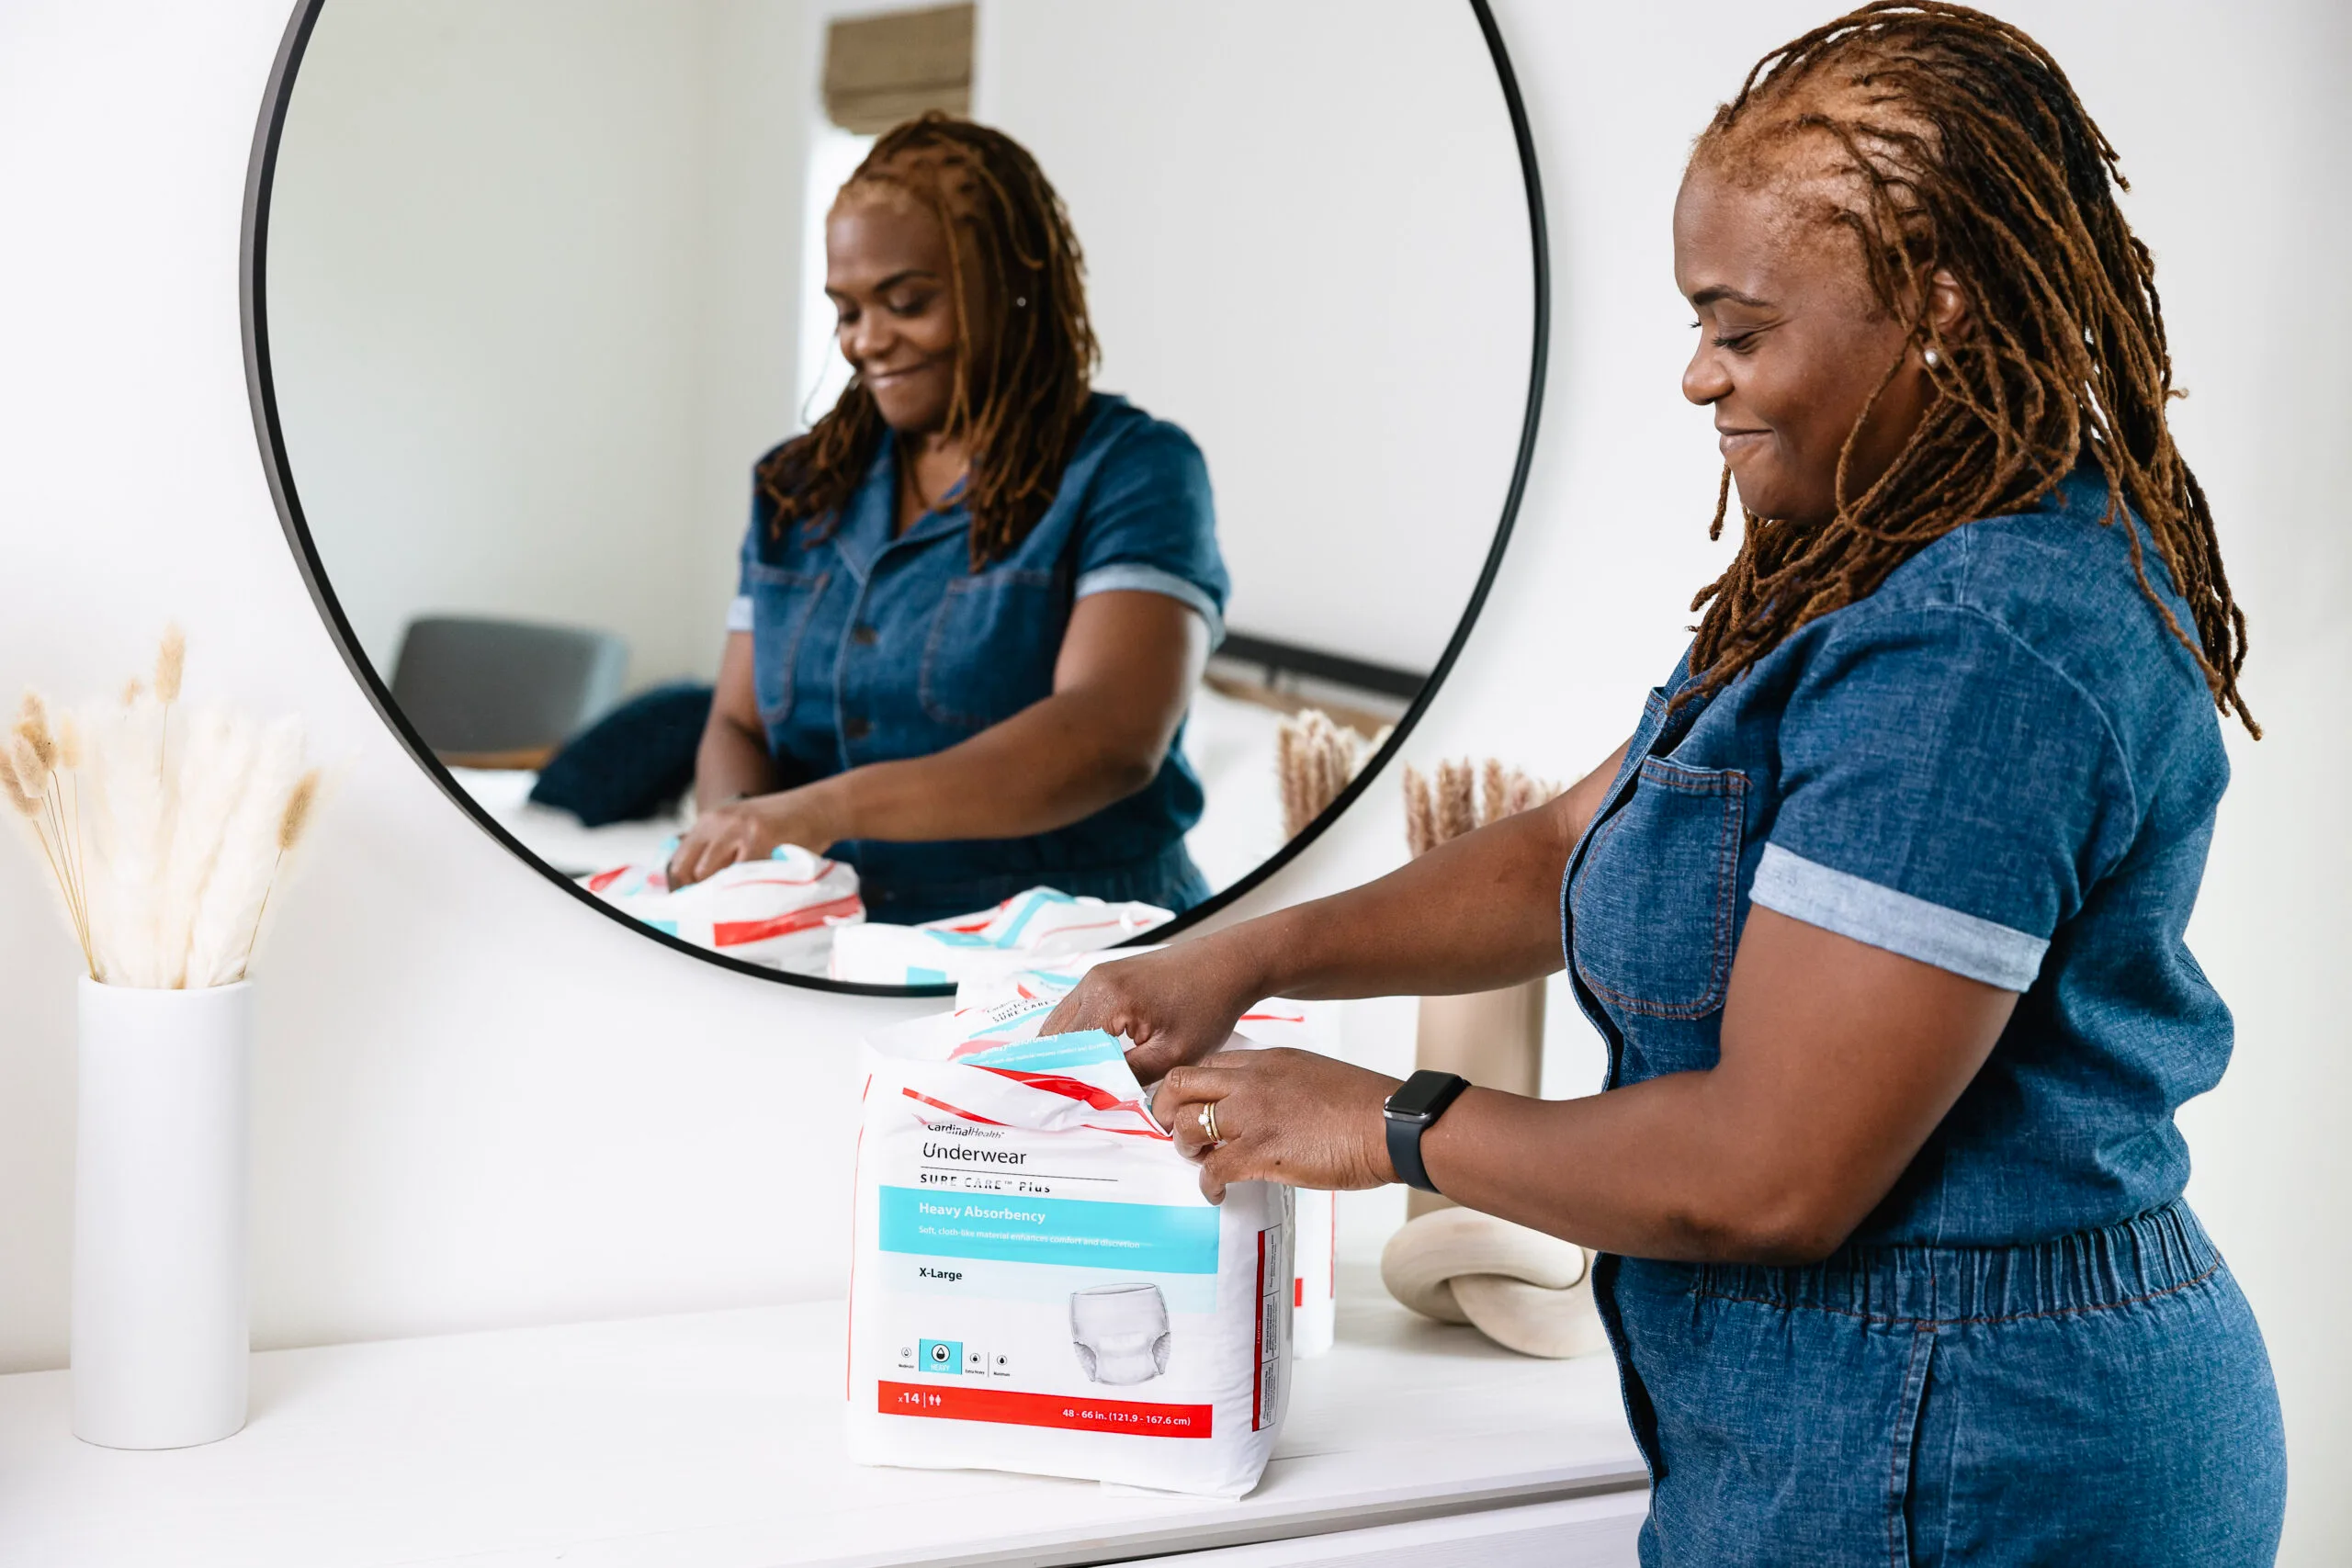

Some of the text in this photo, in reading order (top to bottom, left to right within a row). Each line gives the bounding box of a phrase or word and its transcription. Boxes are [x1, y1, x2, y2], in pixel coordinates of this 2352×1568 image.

[922, 1142, 1027, 1166] Underwear
[921, 1174, 957, 1186] SURE
[1019, 1180, 1051, 1194] Plus
[919, 1201, 1046, 1224] Heavy Absorbency
[918, 1225, 1140, 1248] Soft, cloth-like material enhances comfort and discretion
[919, 1267, 963, 1282] X-Large
[930, 1363, 951, 1371] HEAVY
[1062, 1408, 1074, 1417] 48
[1081, 1411, 1093, 1419] 66
[1095, 1411, 1107, 1420] in.
[1109, 1412, 1137, 1422] (121.9
[1147, 1416, 1171, 1425] 167.6
[1172, 1416, 1191, 1426] cm)
